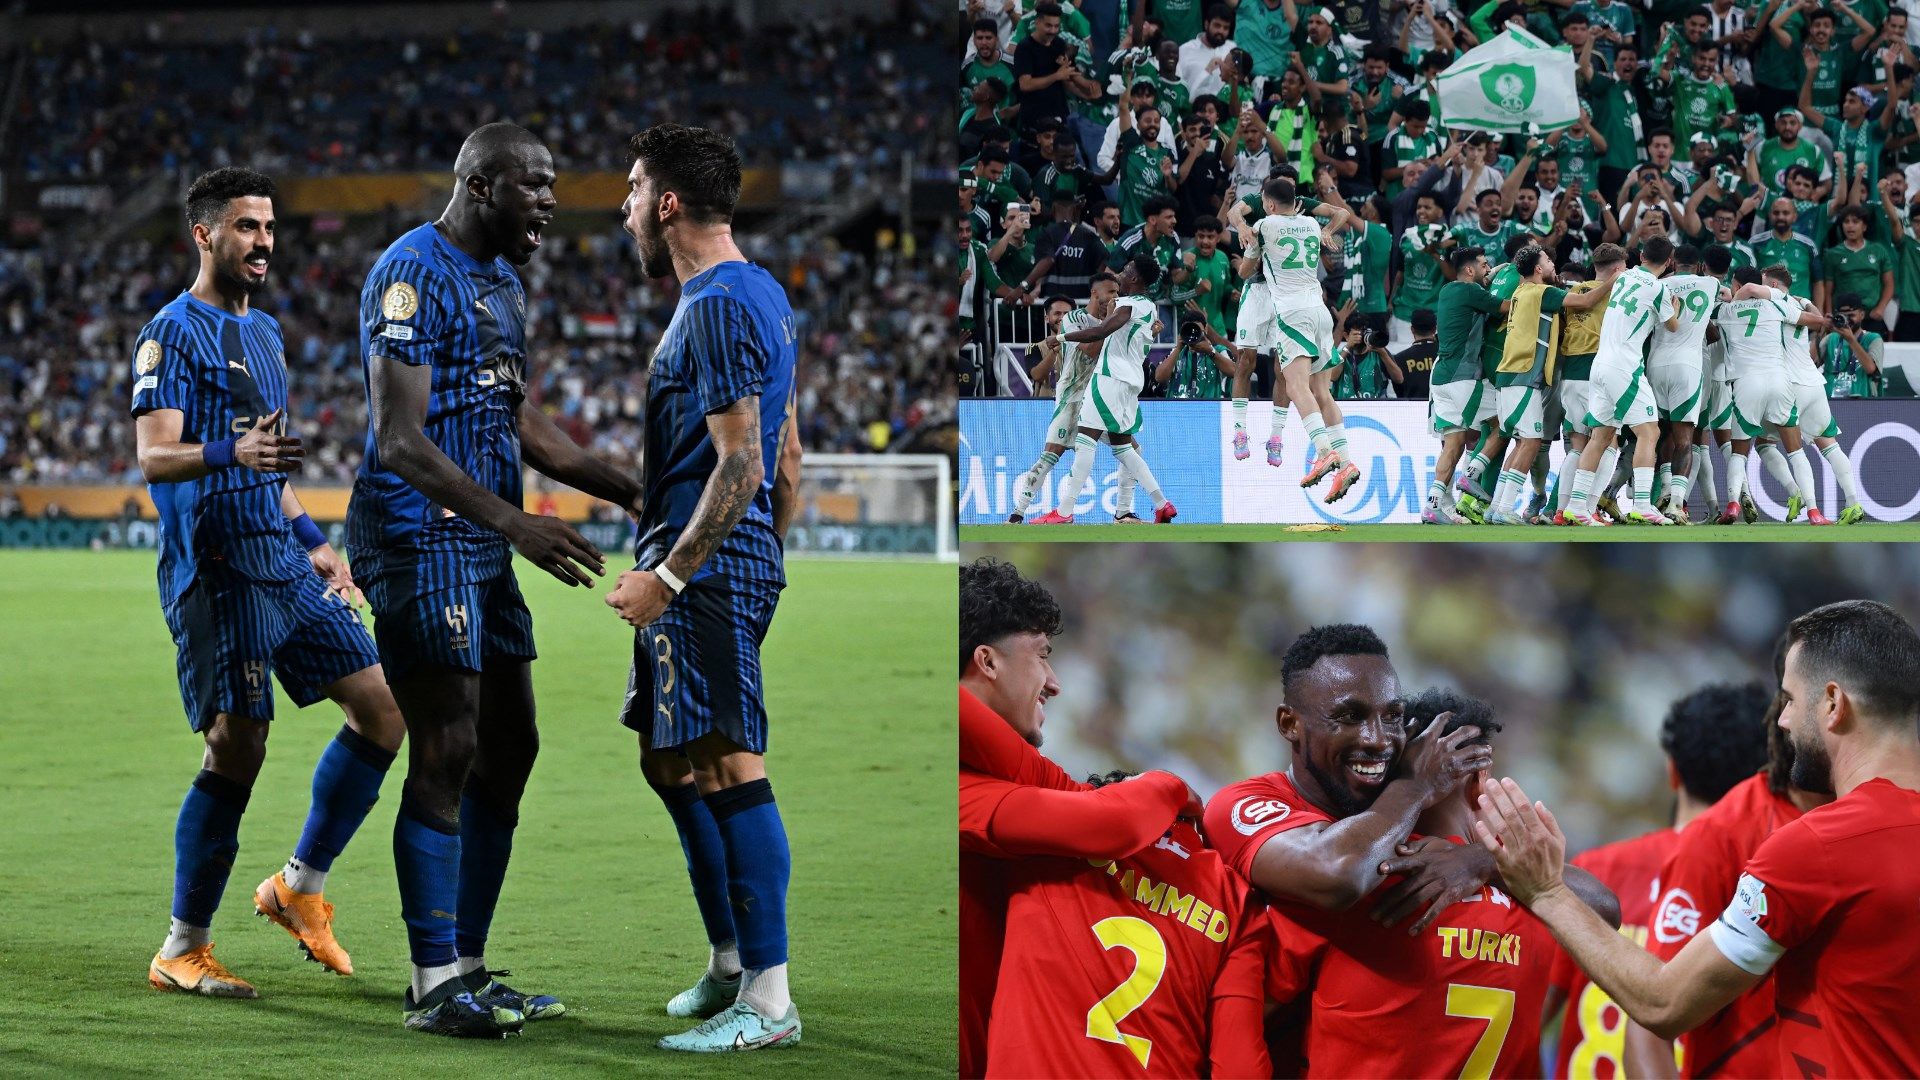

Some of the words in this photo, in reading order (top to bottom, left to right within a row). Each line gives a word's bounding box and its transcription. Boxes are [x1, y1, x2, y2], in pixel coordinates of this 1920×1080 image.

[1062, 245, 1084, 258] 3017
[1276, 235, 1320, 269] 28
[1608, 276, 1642, 316] 24
[1737, 308, 1760, 337] 7
[1437, 926, 1521, 966] TURKI
[1086, 916, 1167, 1070] 2
[1445, 983, 1516, 1080] 7
